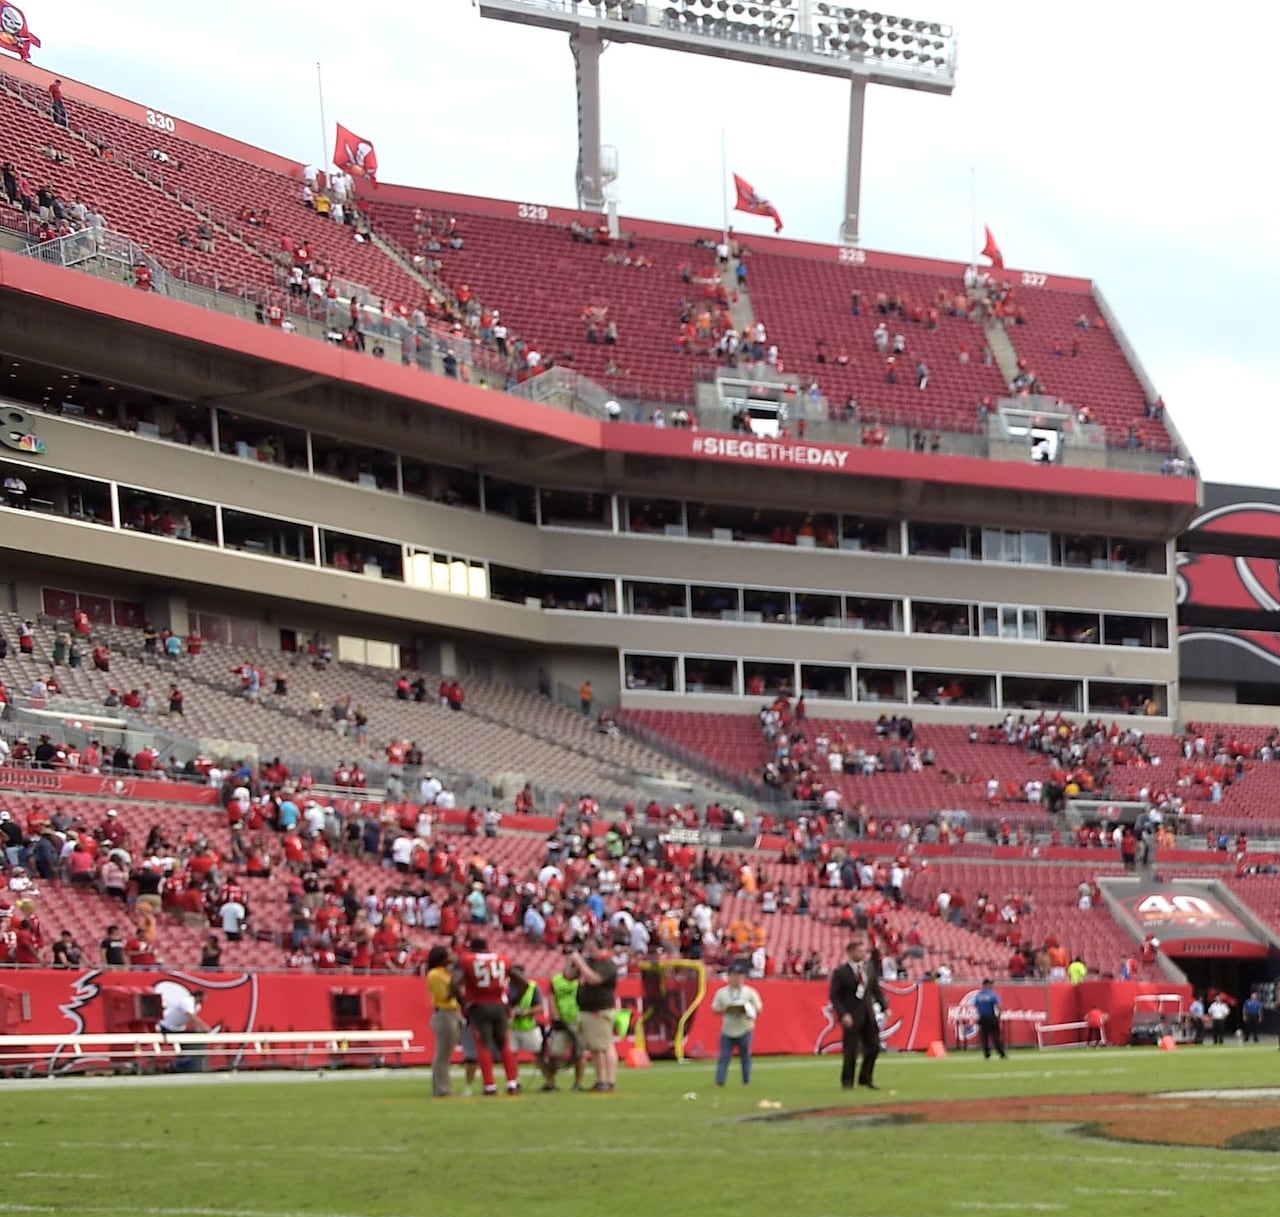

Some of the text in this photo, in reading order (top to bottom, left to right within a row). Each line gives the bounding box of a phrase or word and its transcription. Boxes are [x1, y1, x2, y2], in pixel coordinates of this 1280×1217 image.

[145, 110, 175, 132] 330
[518, 204, 548, 220] 329
[0, 407, 35, 453] 8
[692, 437, 849, 468] #SIEGETHEDAY
[473, 959, 506, 988] 54
